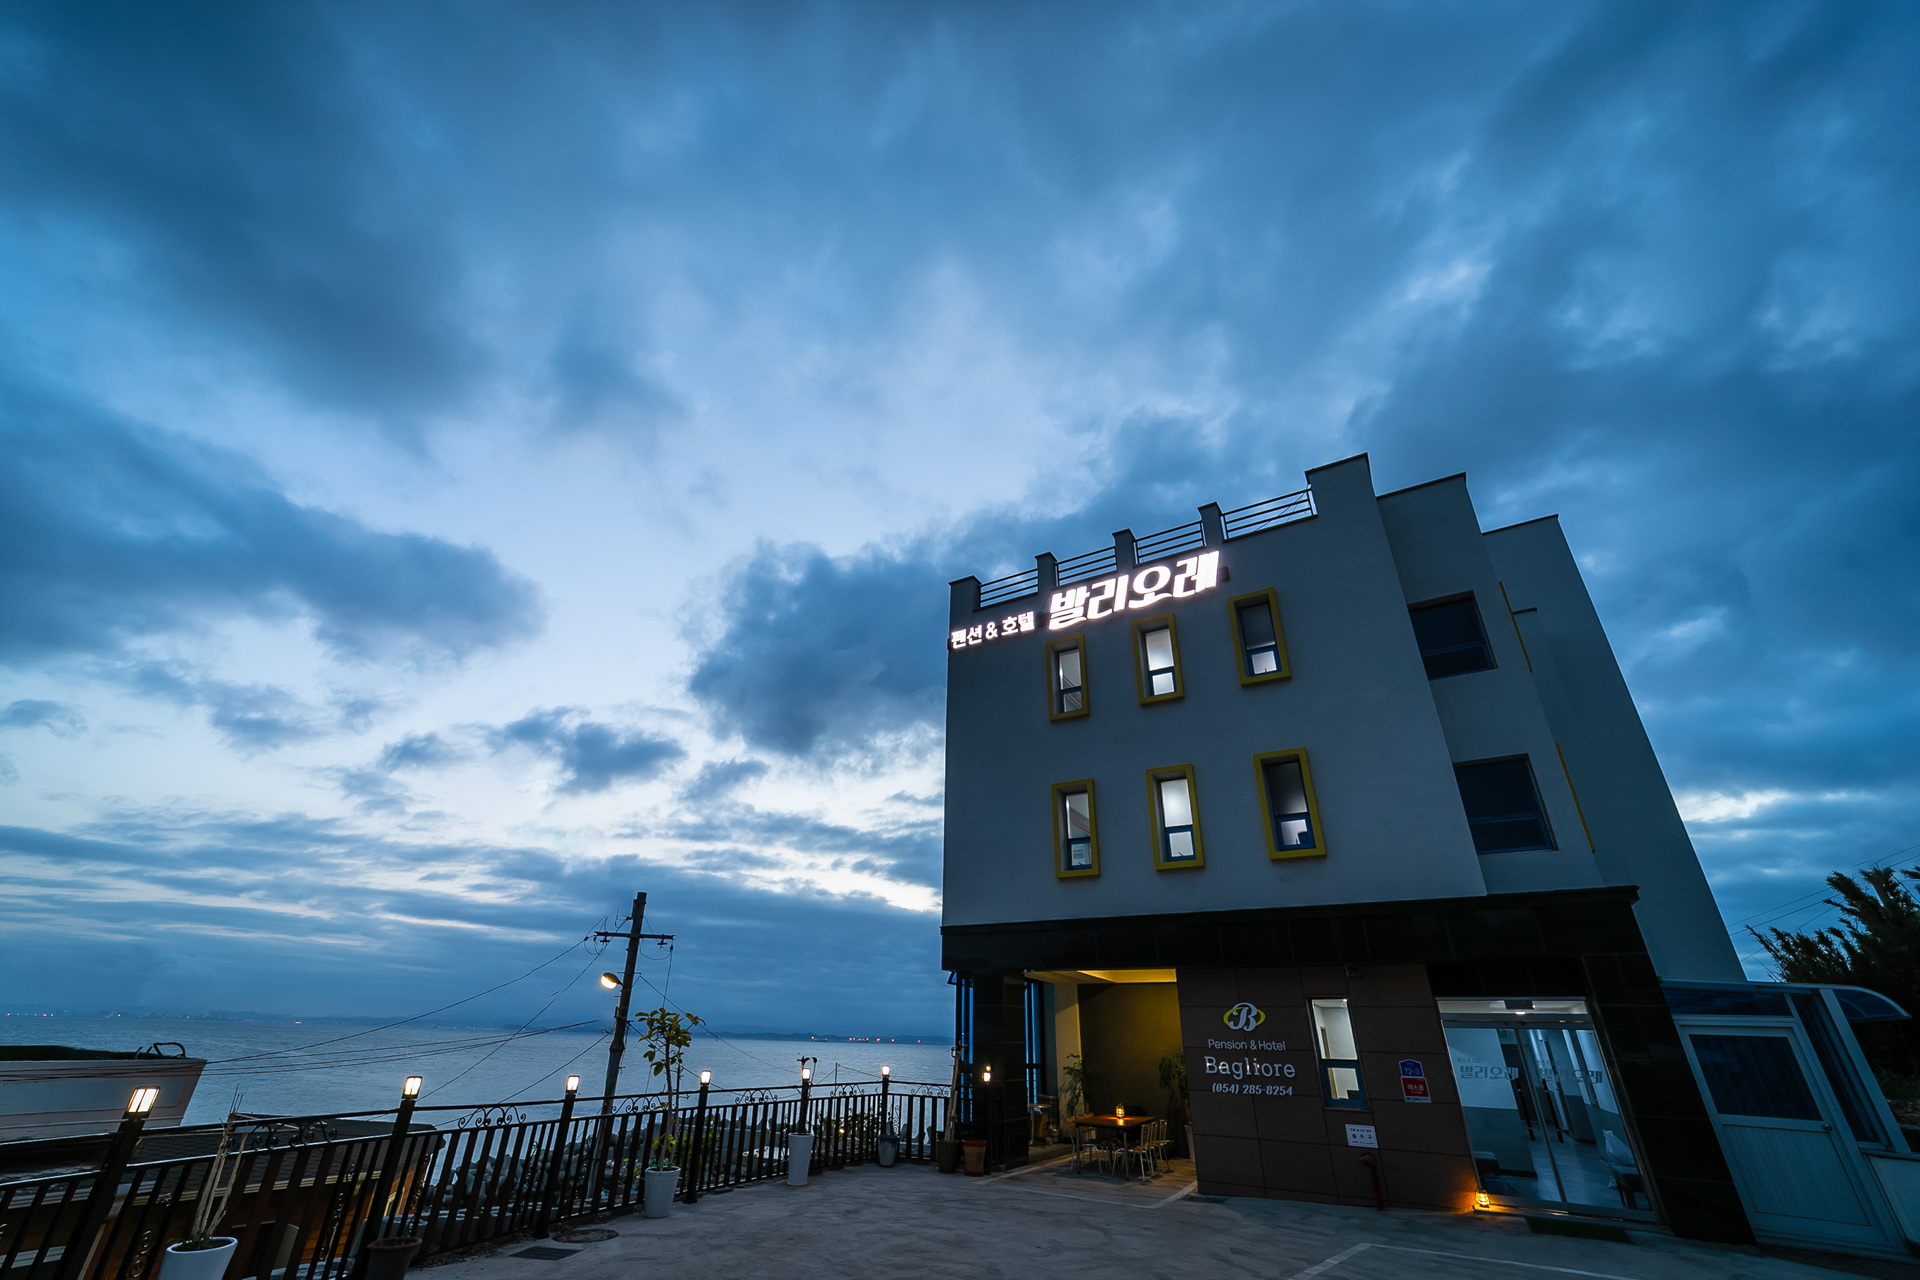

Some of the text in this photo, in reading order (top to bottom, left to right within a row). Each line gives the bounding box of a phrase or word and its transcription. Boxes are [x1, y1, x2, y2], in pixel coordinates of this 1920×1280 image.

[951, 550, 1220, 649] 펜션 & 호텔 발리오레
[1208, 1039, 1286, 1051] Pension & Hotel
[1204, 1056, 1296, 1080] Bagliore
[1460, 1065, 1519, 1080] 발리오레
[1212, 1082, 1293, 1096] (054) 285-8254
